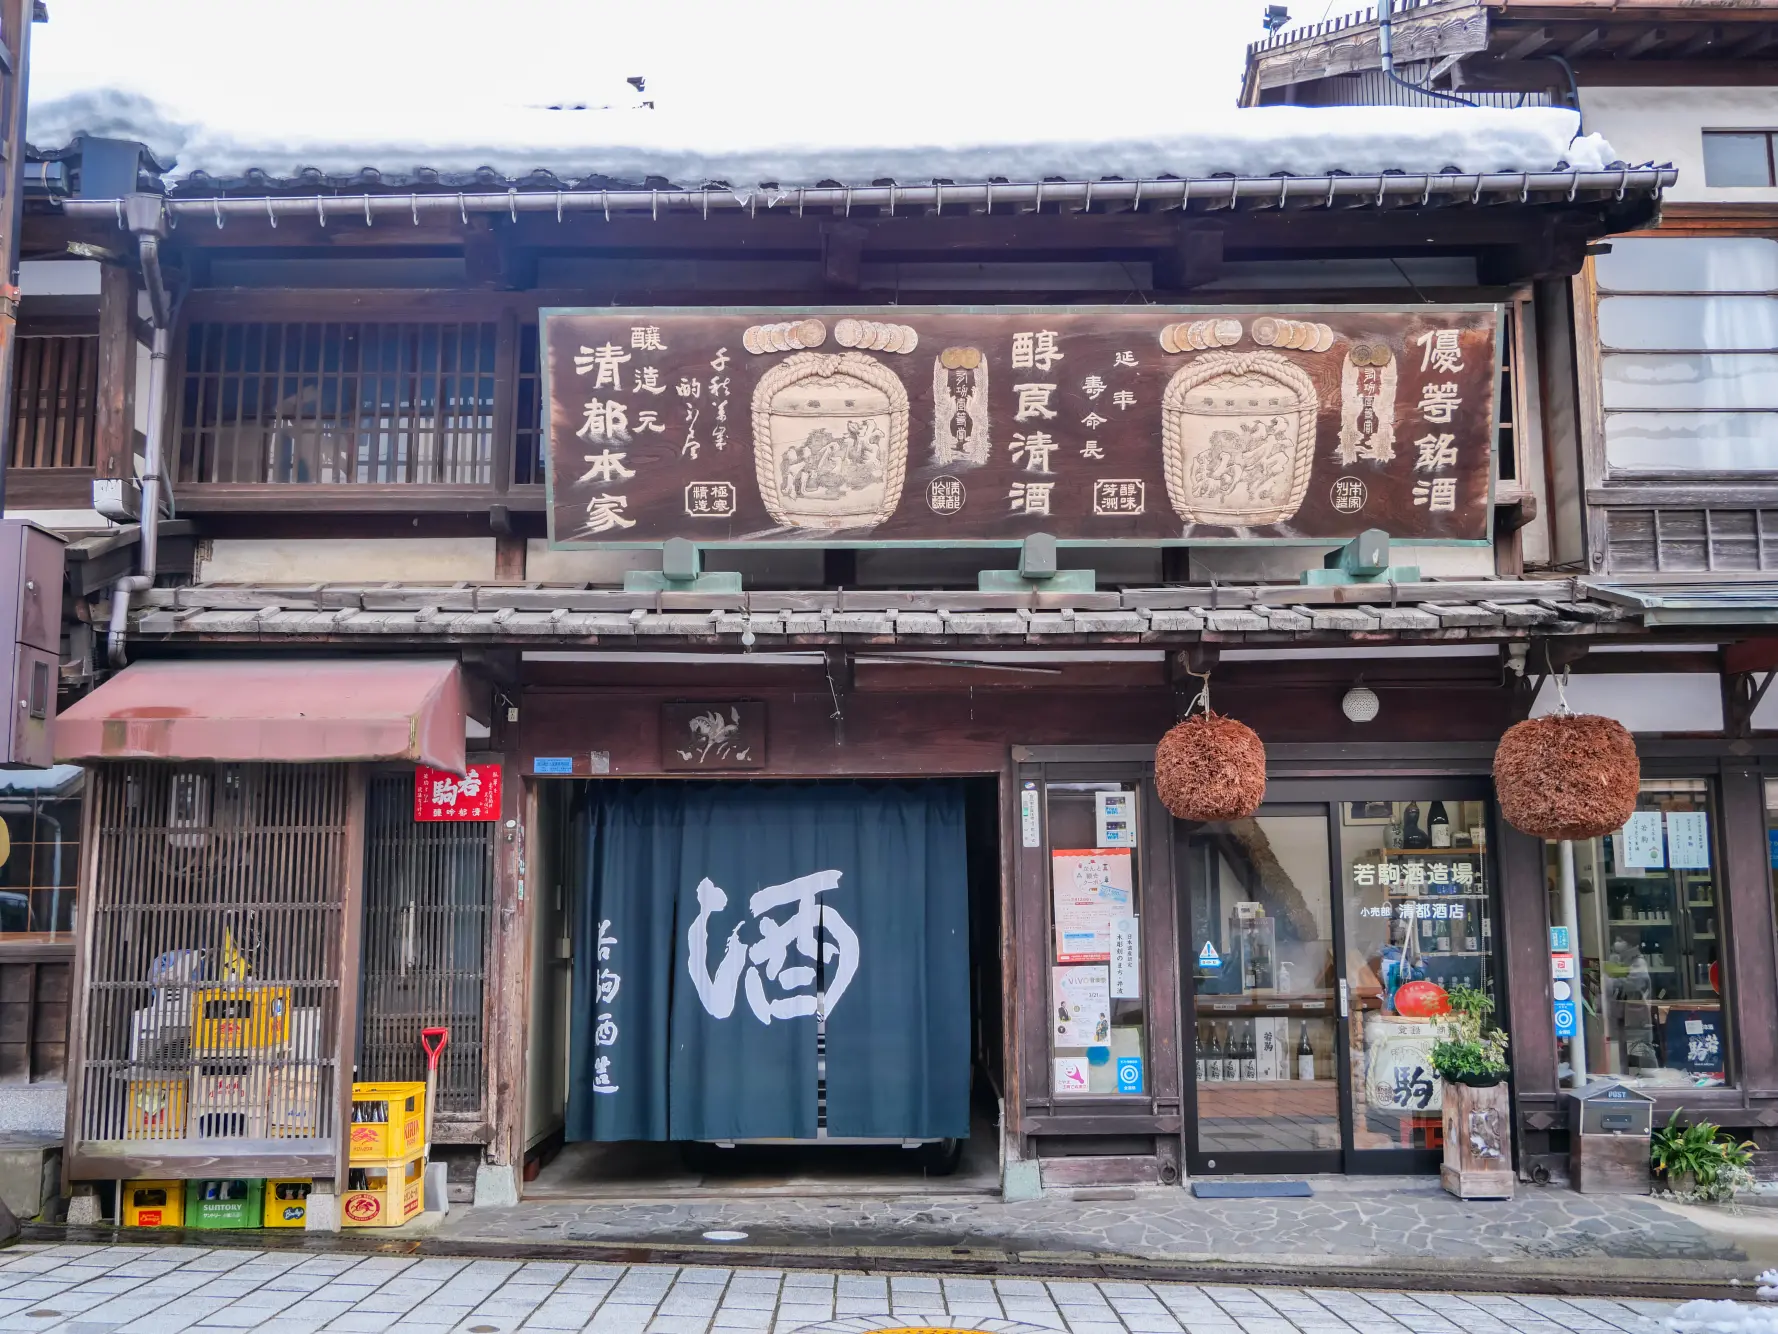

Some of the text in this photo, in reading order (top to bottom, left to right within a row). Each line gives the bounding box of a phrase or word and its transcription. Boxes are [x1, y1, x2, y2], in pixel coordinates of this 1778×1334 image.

[1411, 328, 1465, 512] 優等銘酒
[1353, 862, 1474, 886] 若駒酒造場
[1398, 903, 1465, 919] 清都酒店
[687, 869, 860, 1026] 酒
[1608, 1090, 1626, 1098] POST
[203, 1203, 243, 1212] SUNTORY
